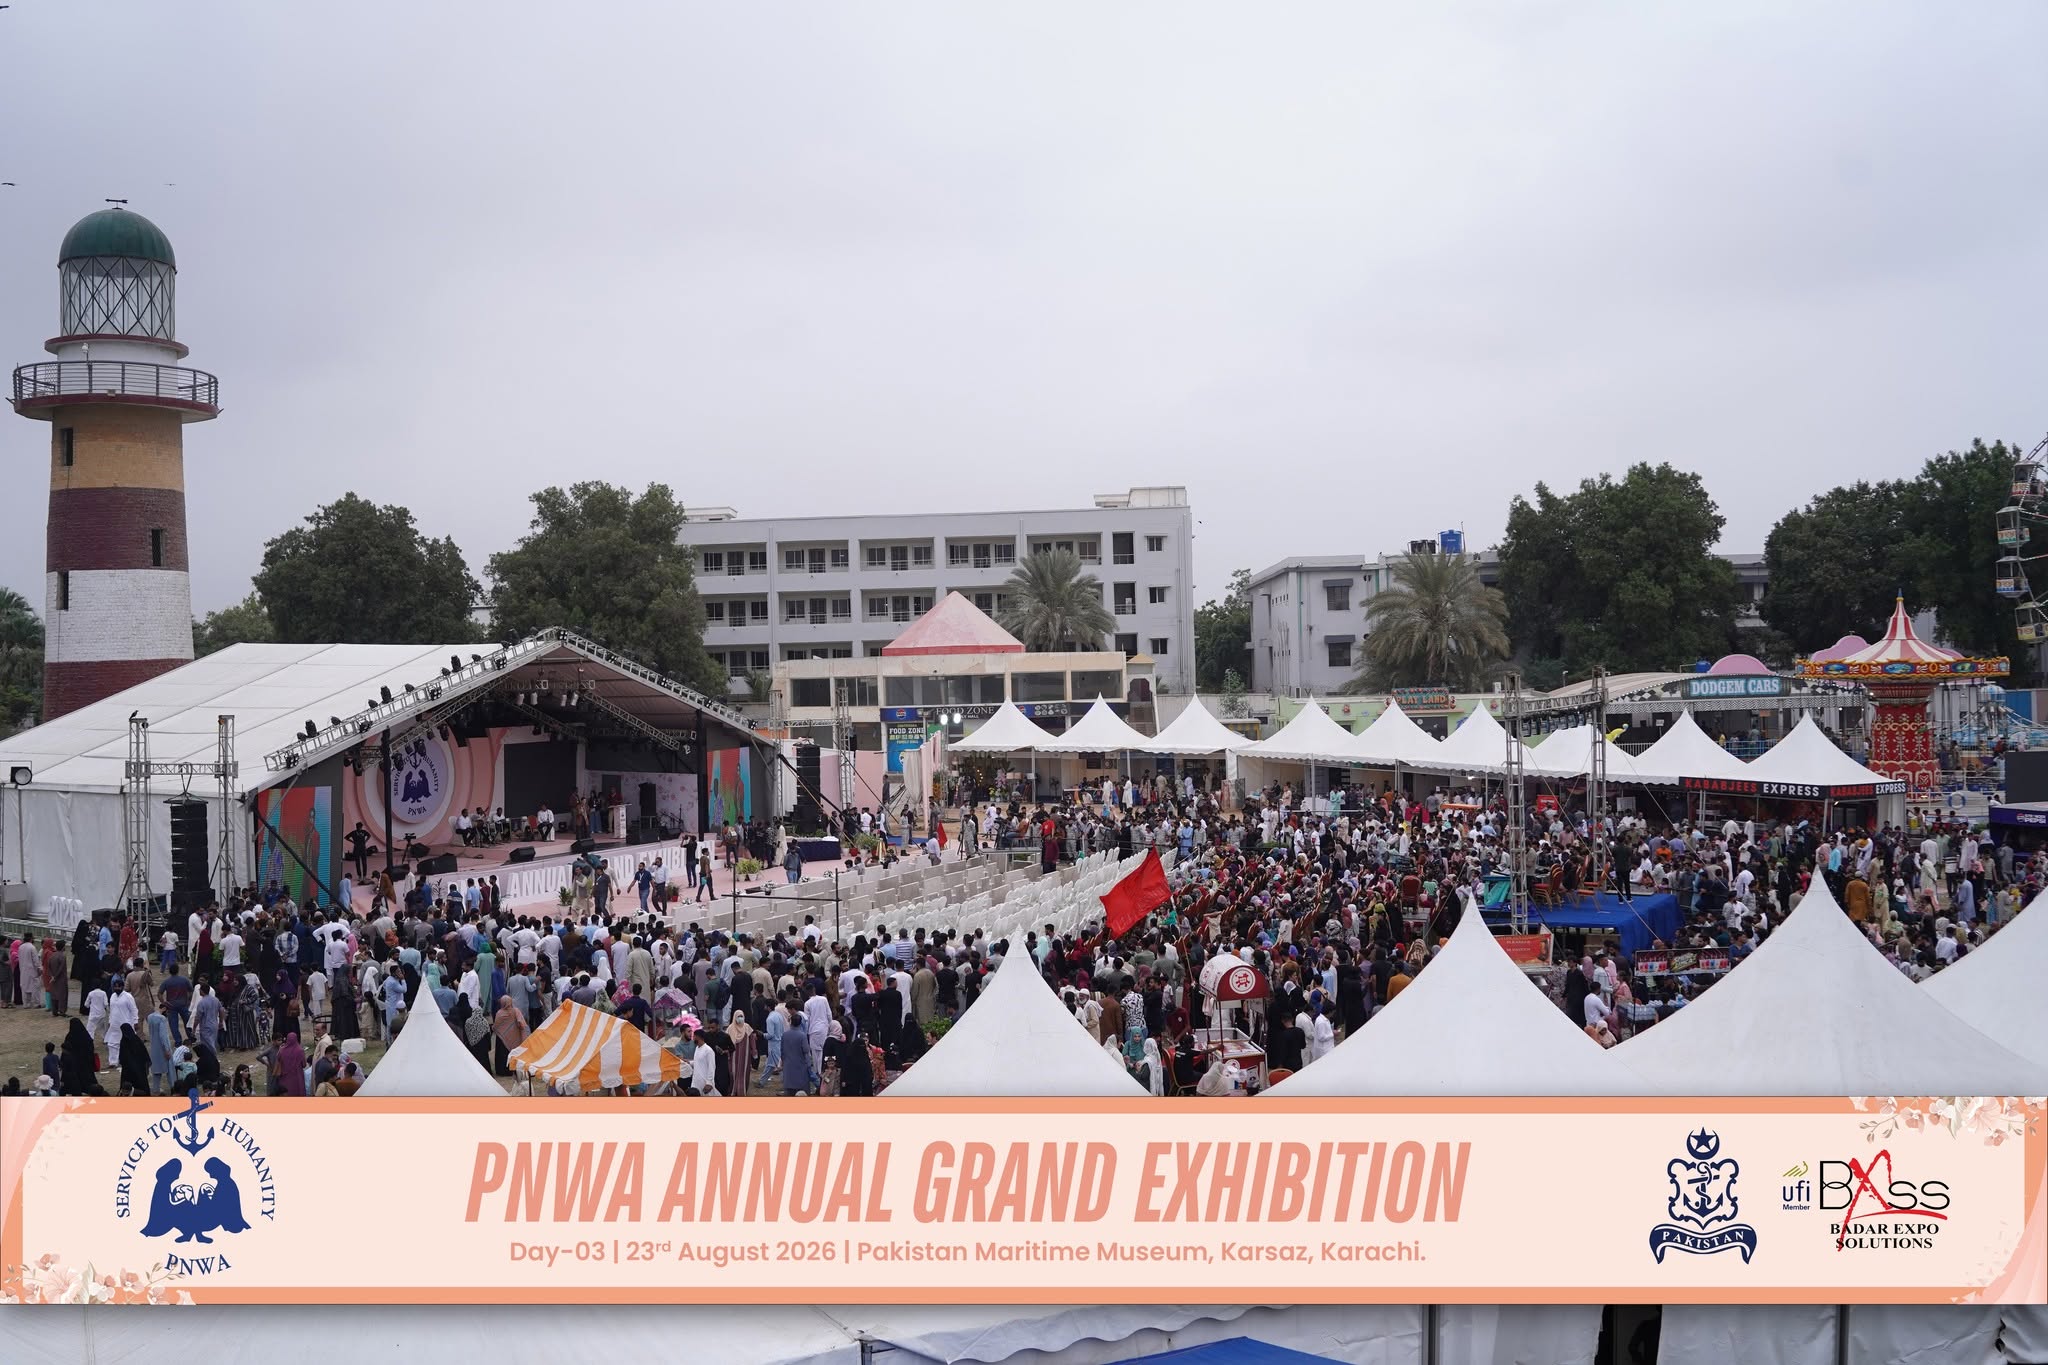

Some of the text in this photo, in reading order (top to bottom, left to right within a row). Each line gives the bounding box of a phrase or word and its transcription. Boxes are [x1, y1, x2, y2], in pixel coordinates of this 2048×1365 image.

[1691, 679, 1780, 695] DODGEM CARS
[1397, 695, 1446, 704] PLAY LAND
[936, 706, 994, 715] FOOD ZONE
[889, 727, 907, 735] FOOD
[1685, 779, 1820, 797] KABABJEES EXPRESS
[1876, 782, 1907, 795] EXPRESS
[407, 806, 427, 816] PNWA
[48, 895, 83, 928] 2026
